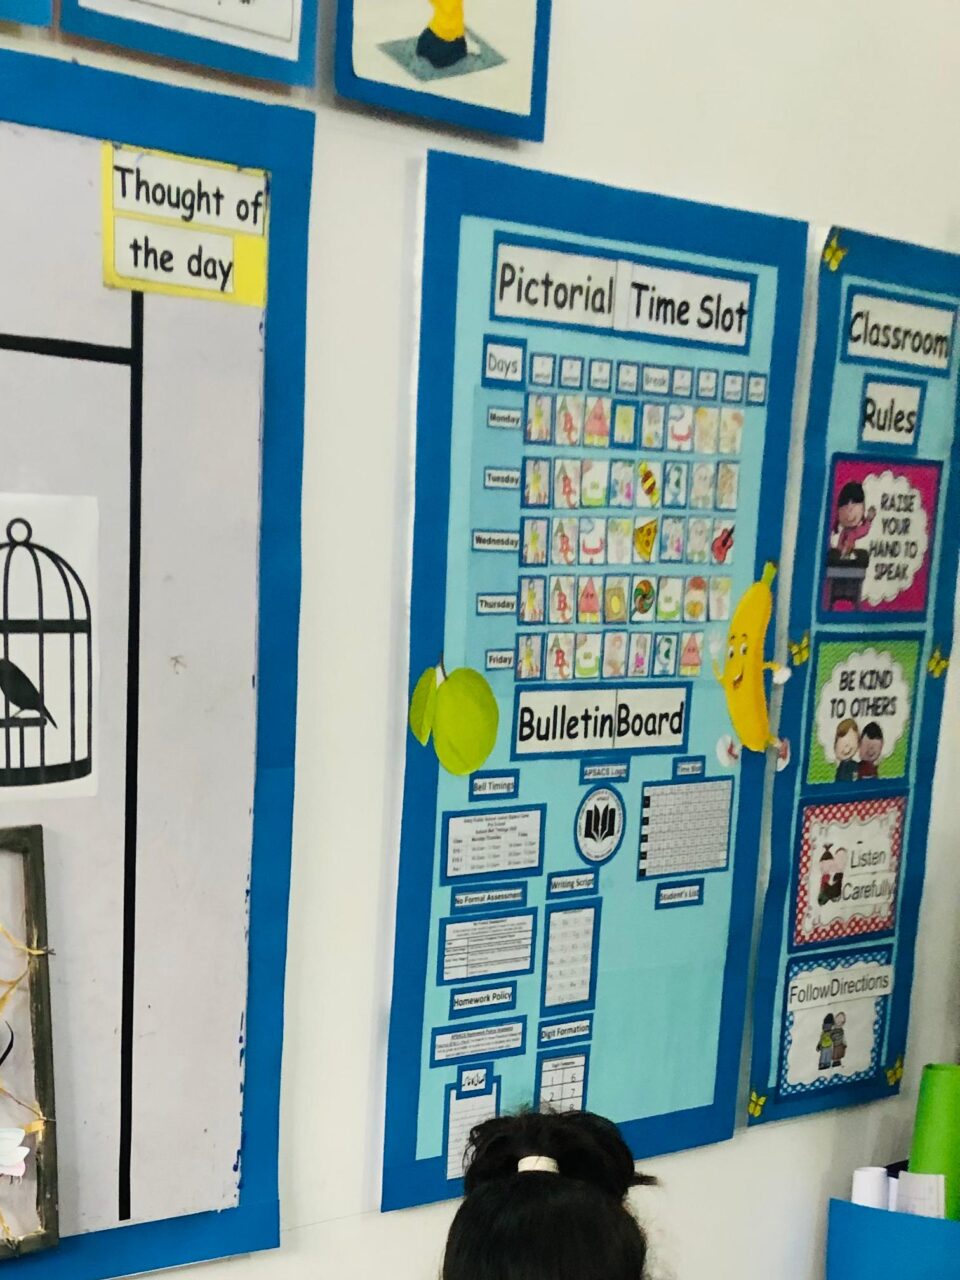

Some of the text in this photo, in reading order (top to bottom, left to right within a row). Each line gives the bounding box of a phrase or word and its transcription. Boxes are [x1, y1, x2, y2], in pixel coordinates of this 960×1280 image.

[113, 165, 263, 225] Thought of
[129, 236, 233, 292] the day
[499, 262, 748, 333] Pictorial Time Slot
[849, 310, 948, 359] Classroom
[489, 353, 517, 378] Days
[489, 413, 520, 425] Monday
[862, 397, 917, 434] Rules
[487, 472, 520, 485] Tuesday
[881, 493, 916, 512] RAISE
[882, 517, 910, 535] YOUR
[475, 536, 519, 548] Wednesday
[869, 540, 918, 558] HAND TO
[874, 562, 909, 581] SPEAK
[478, 599, 515, 611] Thursday
[489, 654, 513, 667] Friday
[839, 670, 893, 691] BE KIND
[830, 696, 897, 719] TO OTHERS
[519, 701, 684, 741] Bulletin Board
[489, 780, 514, 792] Timings
[850, 849, 886, 868] Listen
[551, 878, 575, 890] Writing
[842, 878, 895, 901] Carefully
[464, 894, 485, 904] Formal
[454, 990, 513, 1007] Homework Policy
[542, 1023, 589, 1040] Digit Formation
